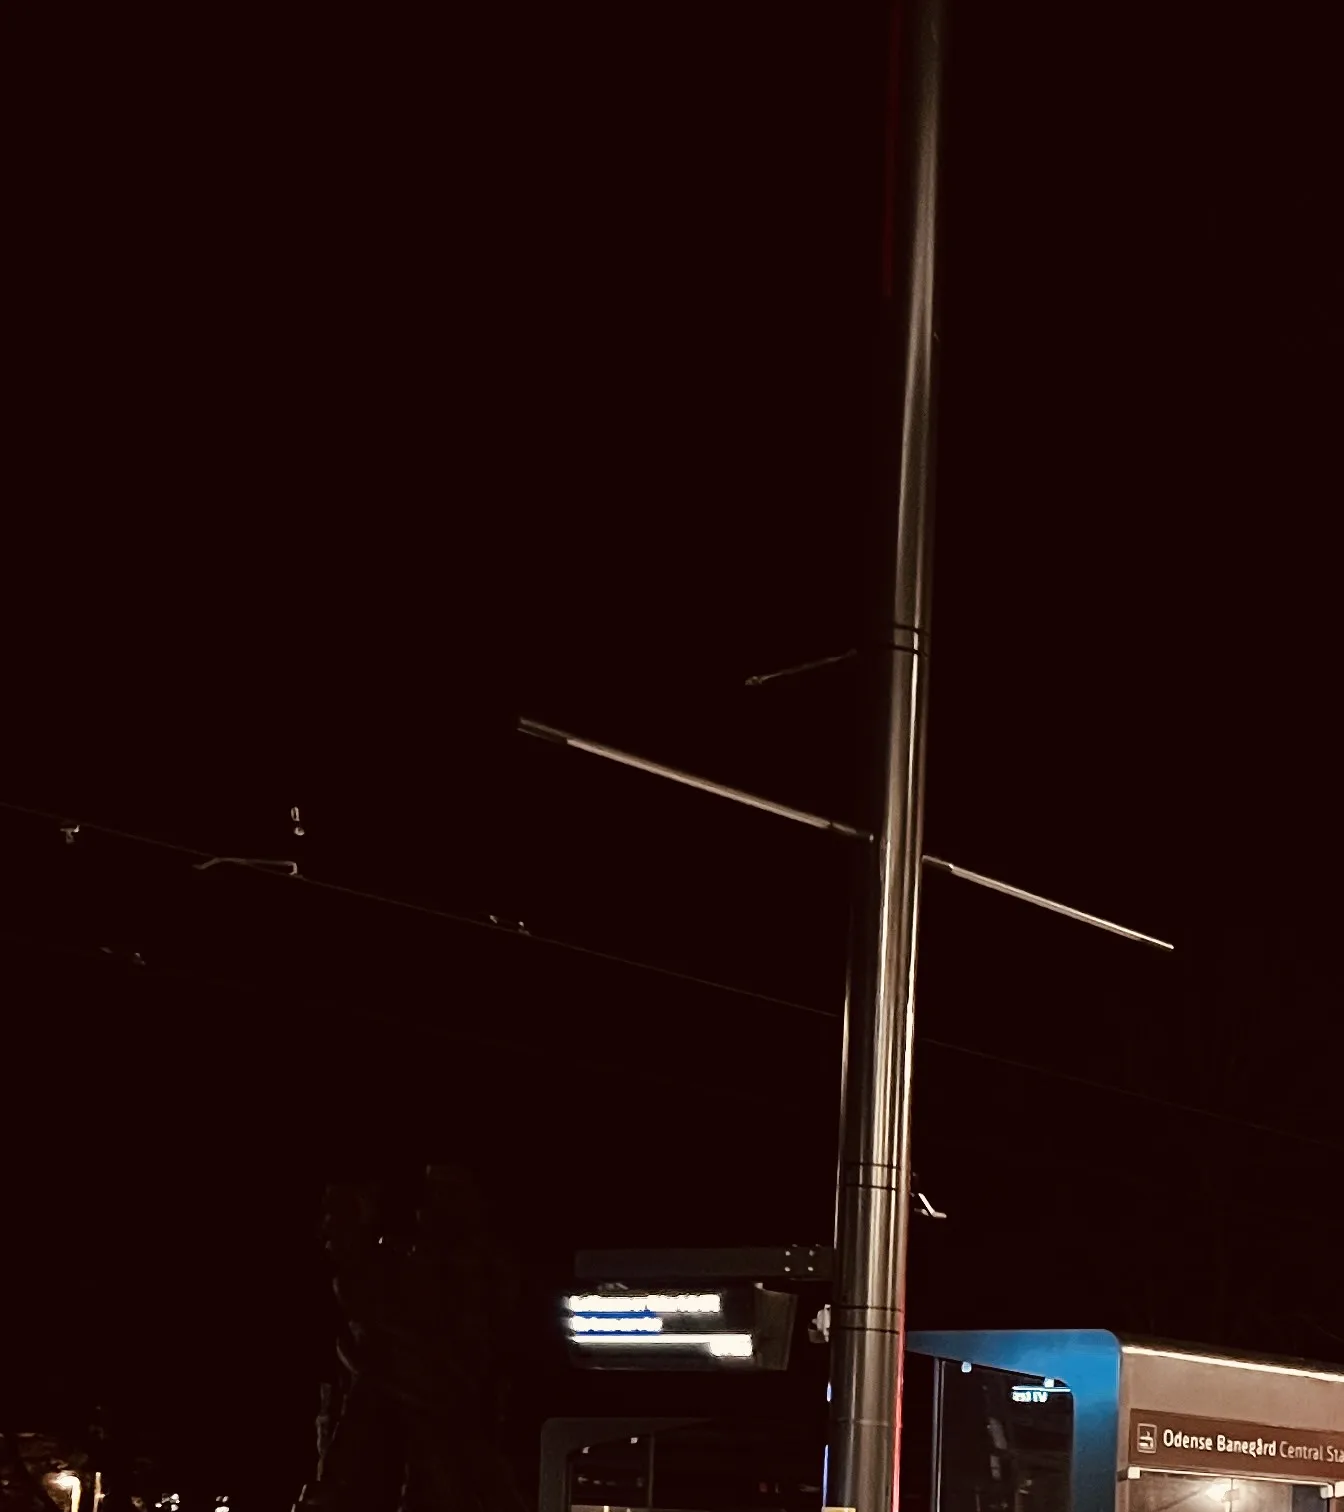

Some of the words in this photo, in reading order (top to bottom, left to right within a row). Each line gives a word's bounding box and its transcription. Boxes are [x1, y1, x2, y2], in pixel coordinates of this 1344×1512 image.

[1163, 1428, 1213, 1451] Odense
[1216, 1434, 1277, 1458] Banegård
[1279, 1440, 1324, 1462] Central
